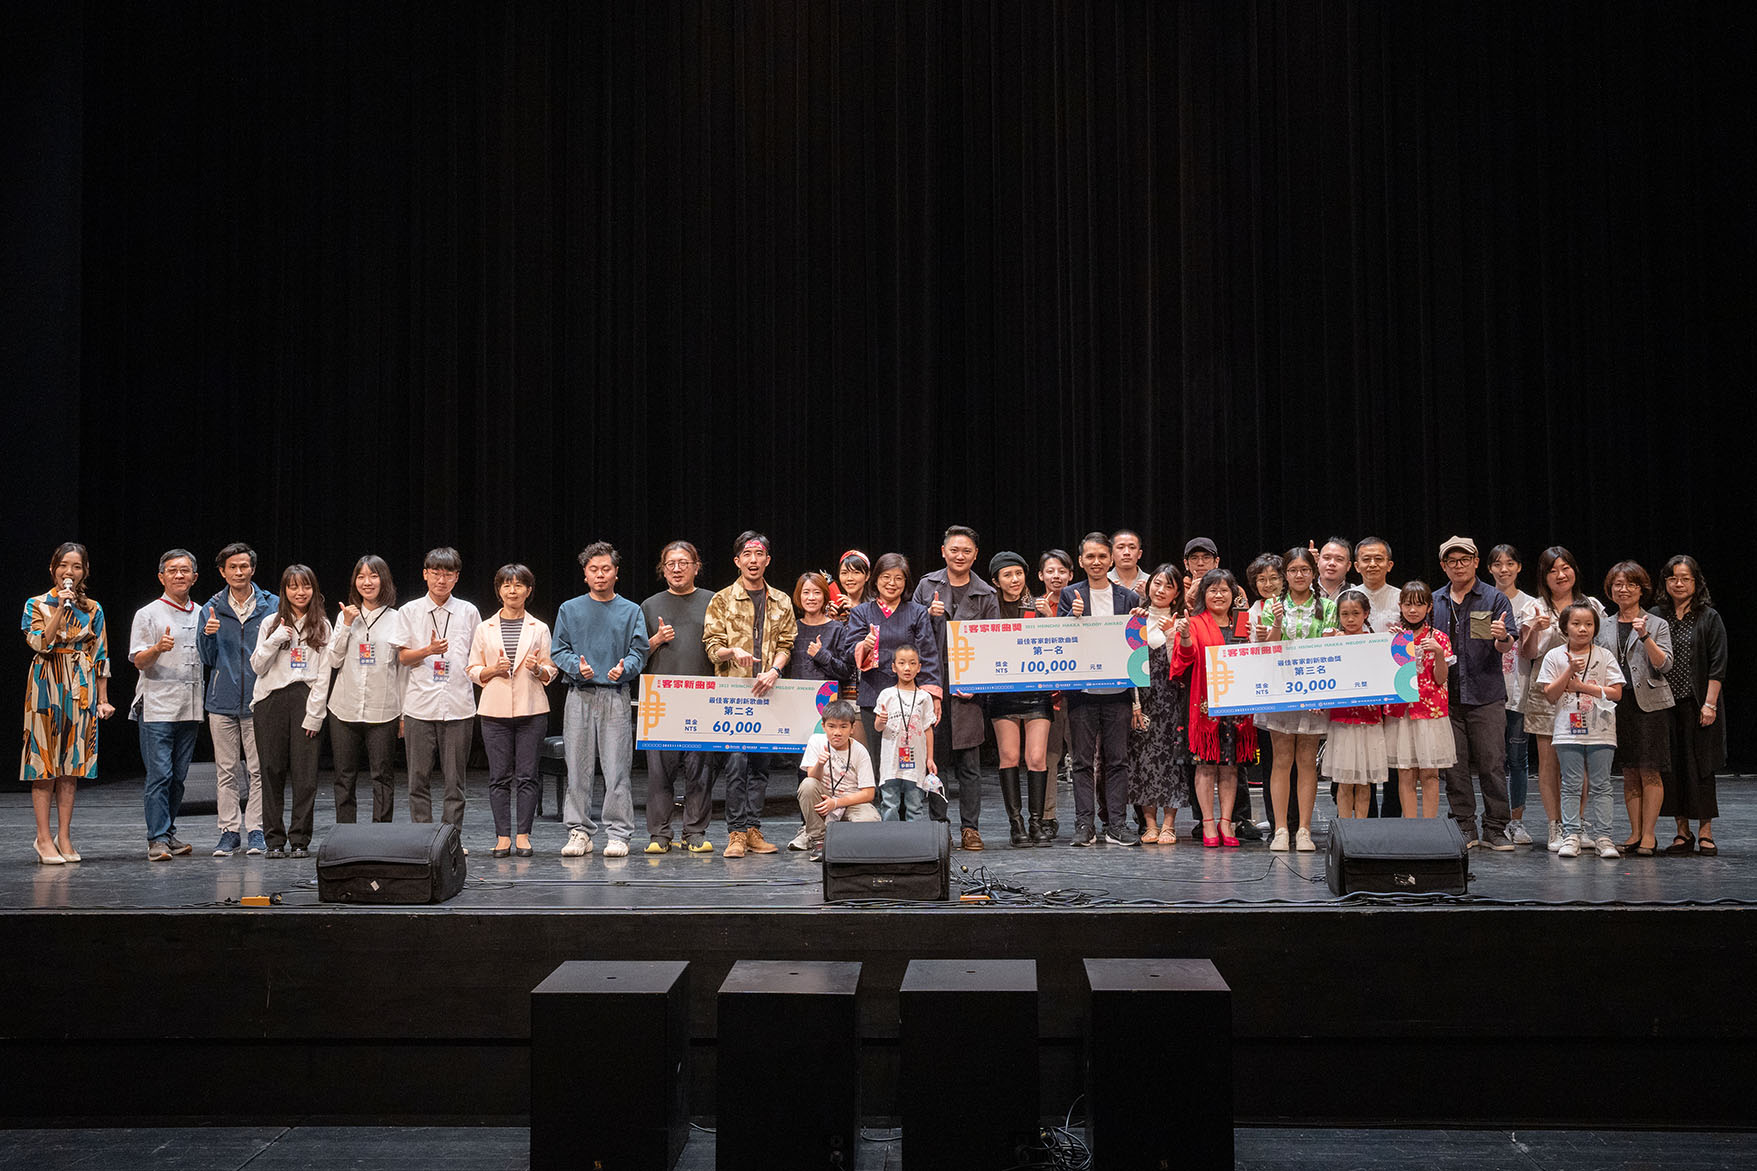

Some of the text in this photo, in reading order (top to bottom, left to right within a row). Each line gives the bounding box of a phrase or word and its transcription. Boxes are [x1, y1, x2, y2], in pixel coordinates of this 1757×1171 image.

[1032, 645, 1063, 655] 第一名
[1021, 659, 1077, 675] 100,000
[1294, 665, 1326, 676] 第三名
[1285, 678, 1337, 695] 30,000
[723, 706, 754, 716] 第二名
[712, 720, 762, 736] 60,000
